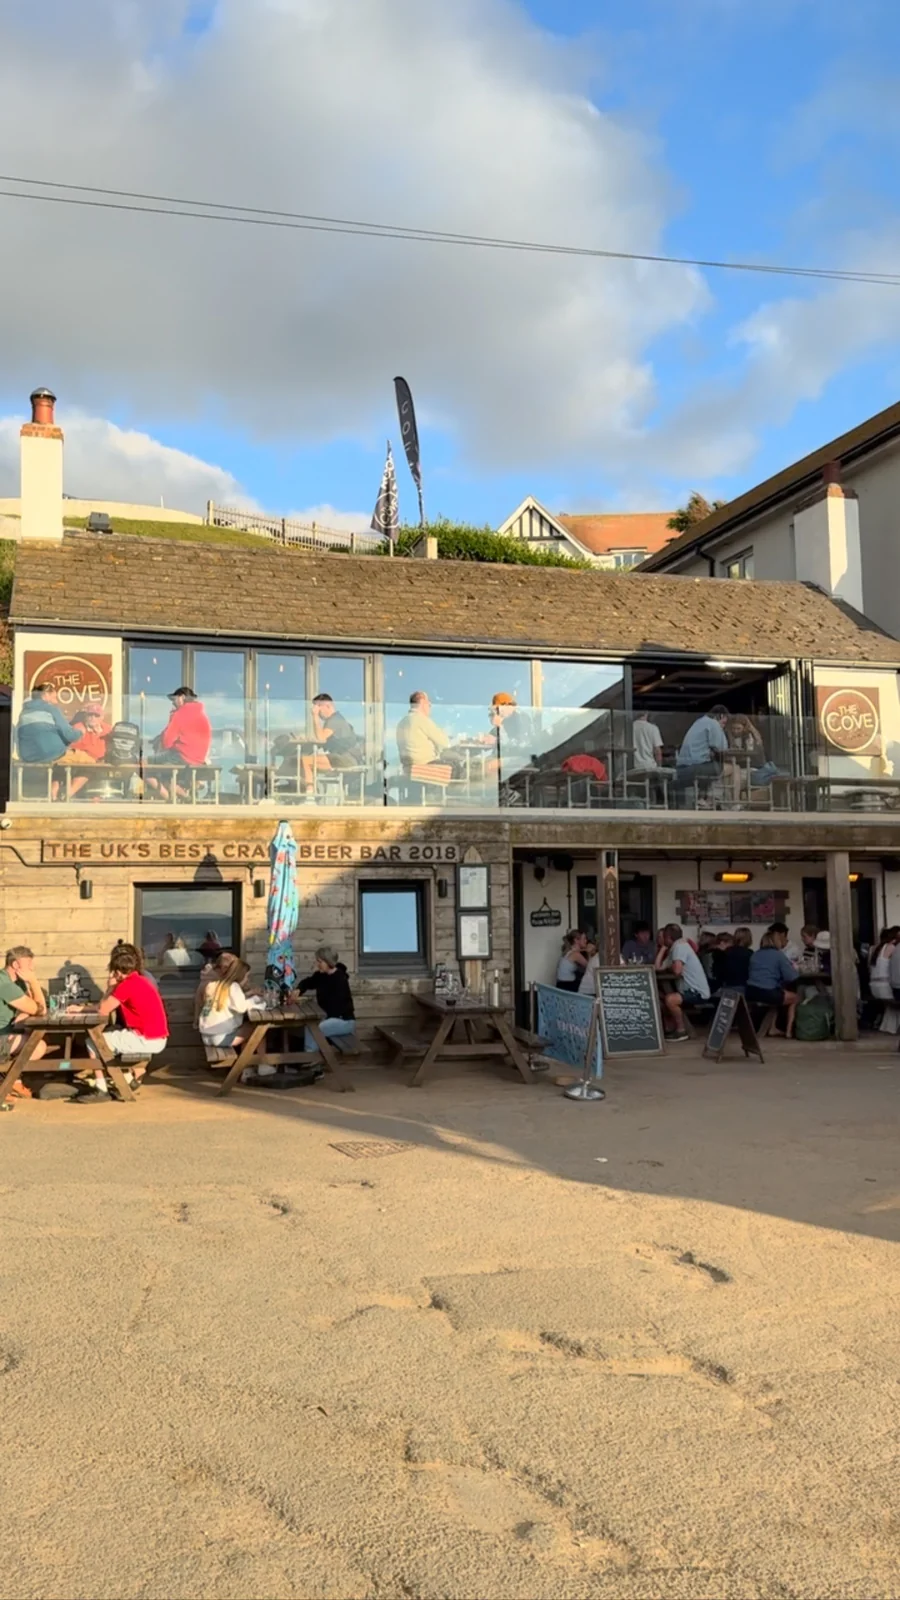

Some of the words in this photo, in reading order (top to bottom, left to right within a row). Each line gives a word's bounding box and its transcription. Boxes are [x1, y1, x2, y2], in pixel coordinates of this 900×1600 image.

[54, 674, 80, 686] THE
[43, 682, 101, 704] OVE
[838, 705, 857, 716] THE
[827, 711, 873, 731] COVE
[48, 843, 92, 858] THE
[101, 843, 151, 858] UK'S
[159, 843, 215, 858] BEST
[222, 844, 271, 858] CRA
[300, 845, 352, 859] BEER
[360, 845, 402, 860] BAR
[409, 846, 456, 860] 2018
